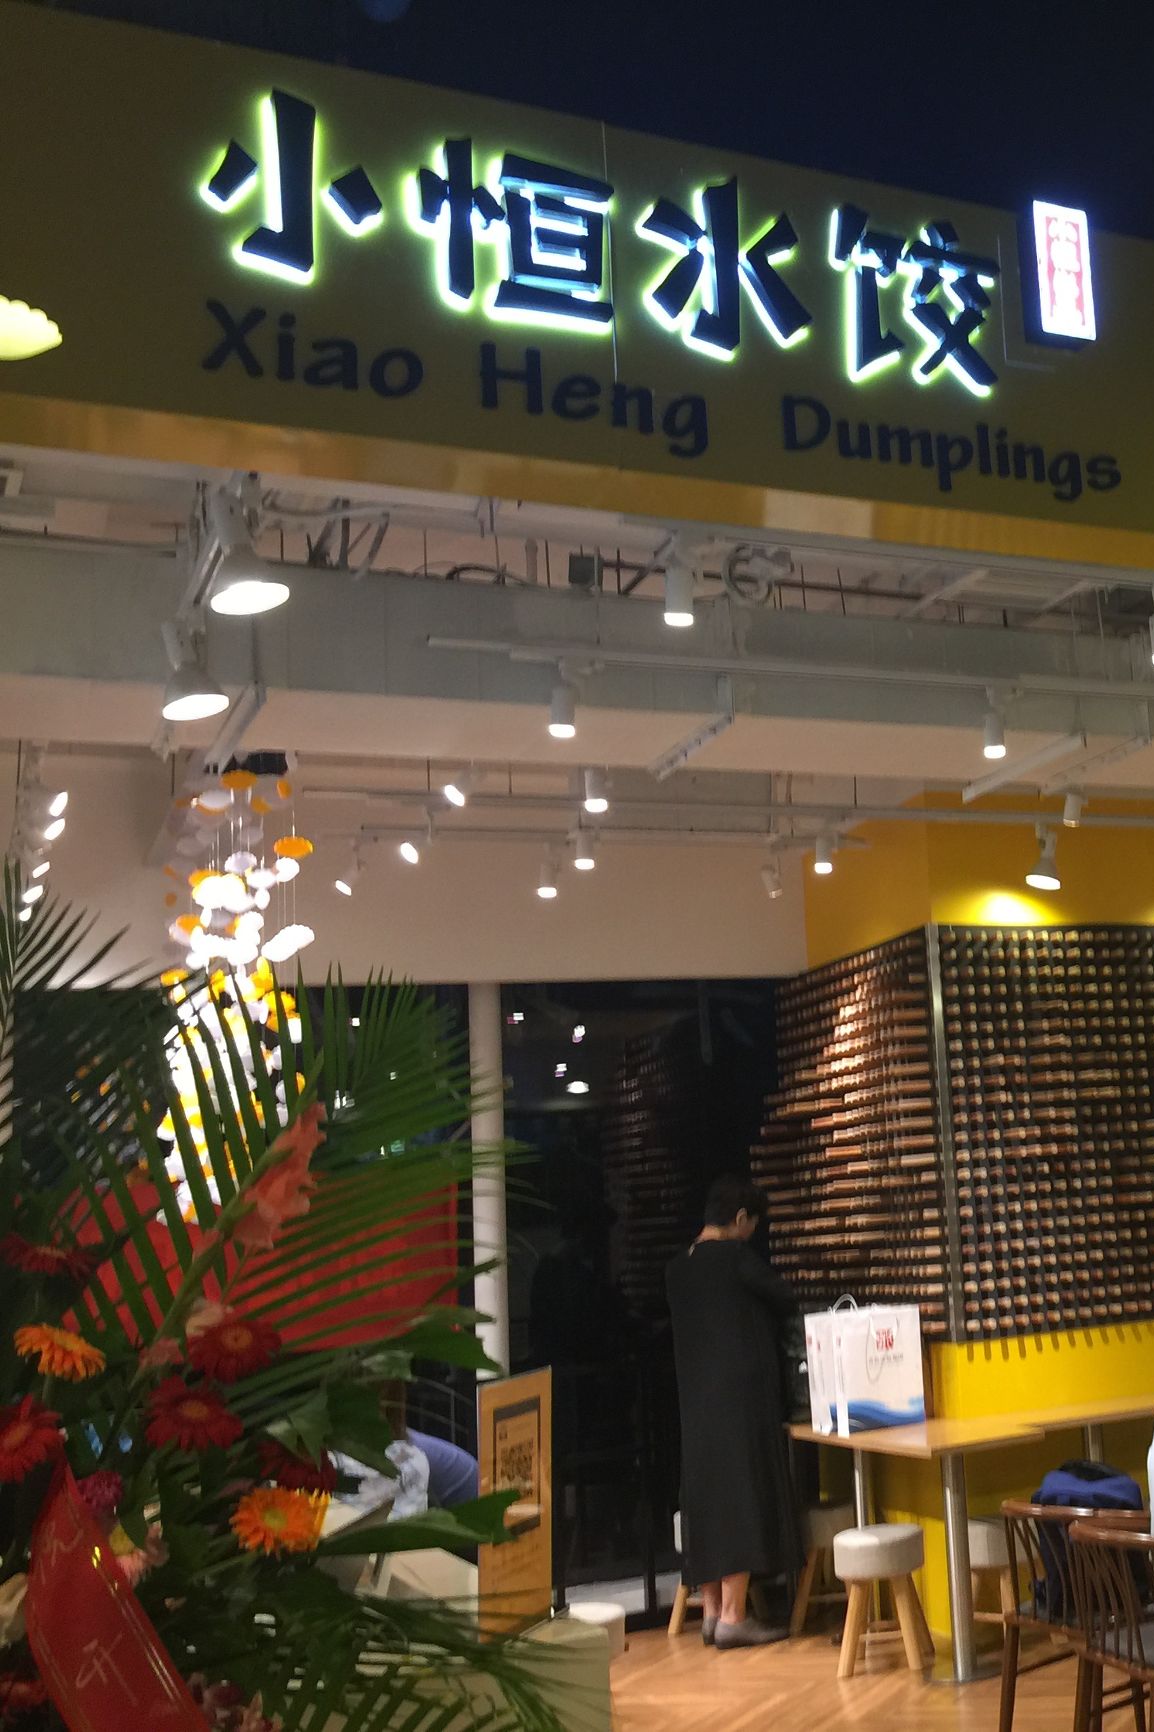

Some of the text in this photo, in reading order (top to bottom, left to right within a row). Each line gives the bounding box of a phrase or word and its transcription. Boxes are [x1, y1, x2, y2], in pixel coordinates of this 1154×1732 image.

[201, 89, 1000, 396] 小恒水饺
[202, 299, 1122, 503] Xiao Heng Dumplings
